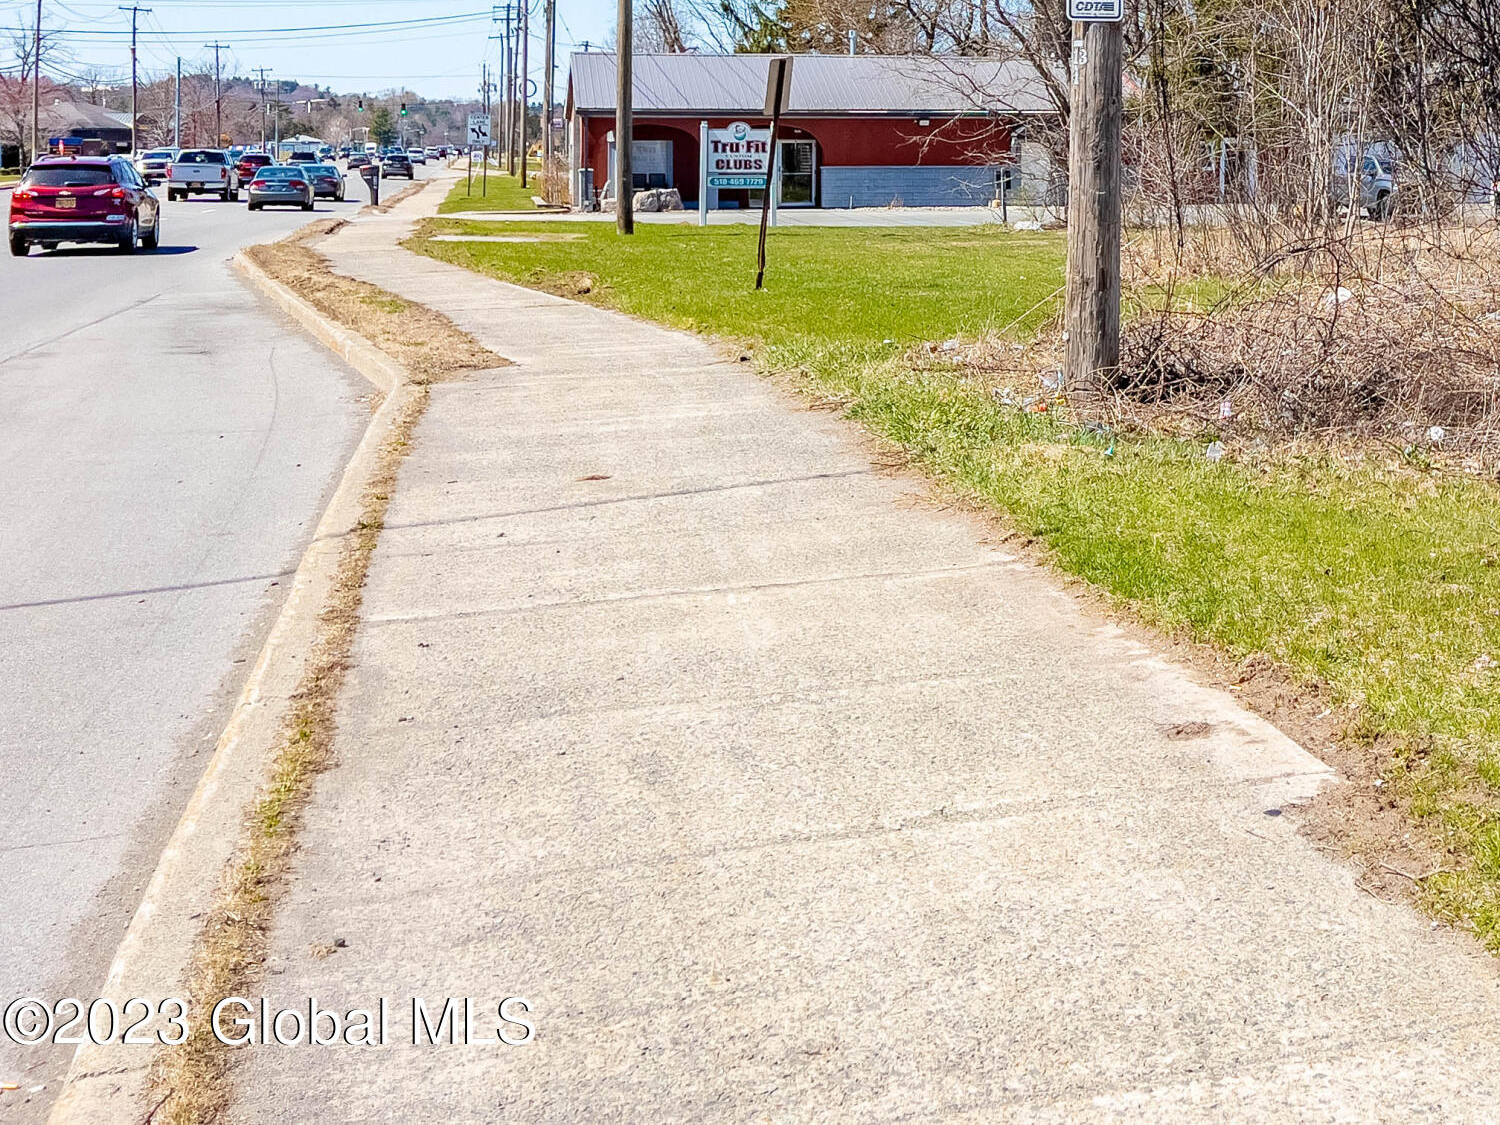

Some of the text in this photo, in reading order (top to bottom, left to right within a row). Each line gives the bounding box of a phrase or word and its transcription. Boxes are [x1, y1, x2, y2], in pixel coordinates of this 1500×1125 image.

[710, 140, 768, 153] Tru Fit
[715, 159, 763, 170] CLUBS
